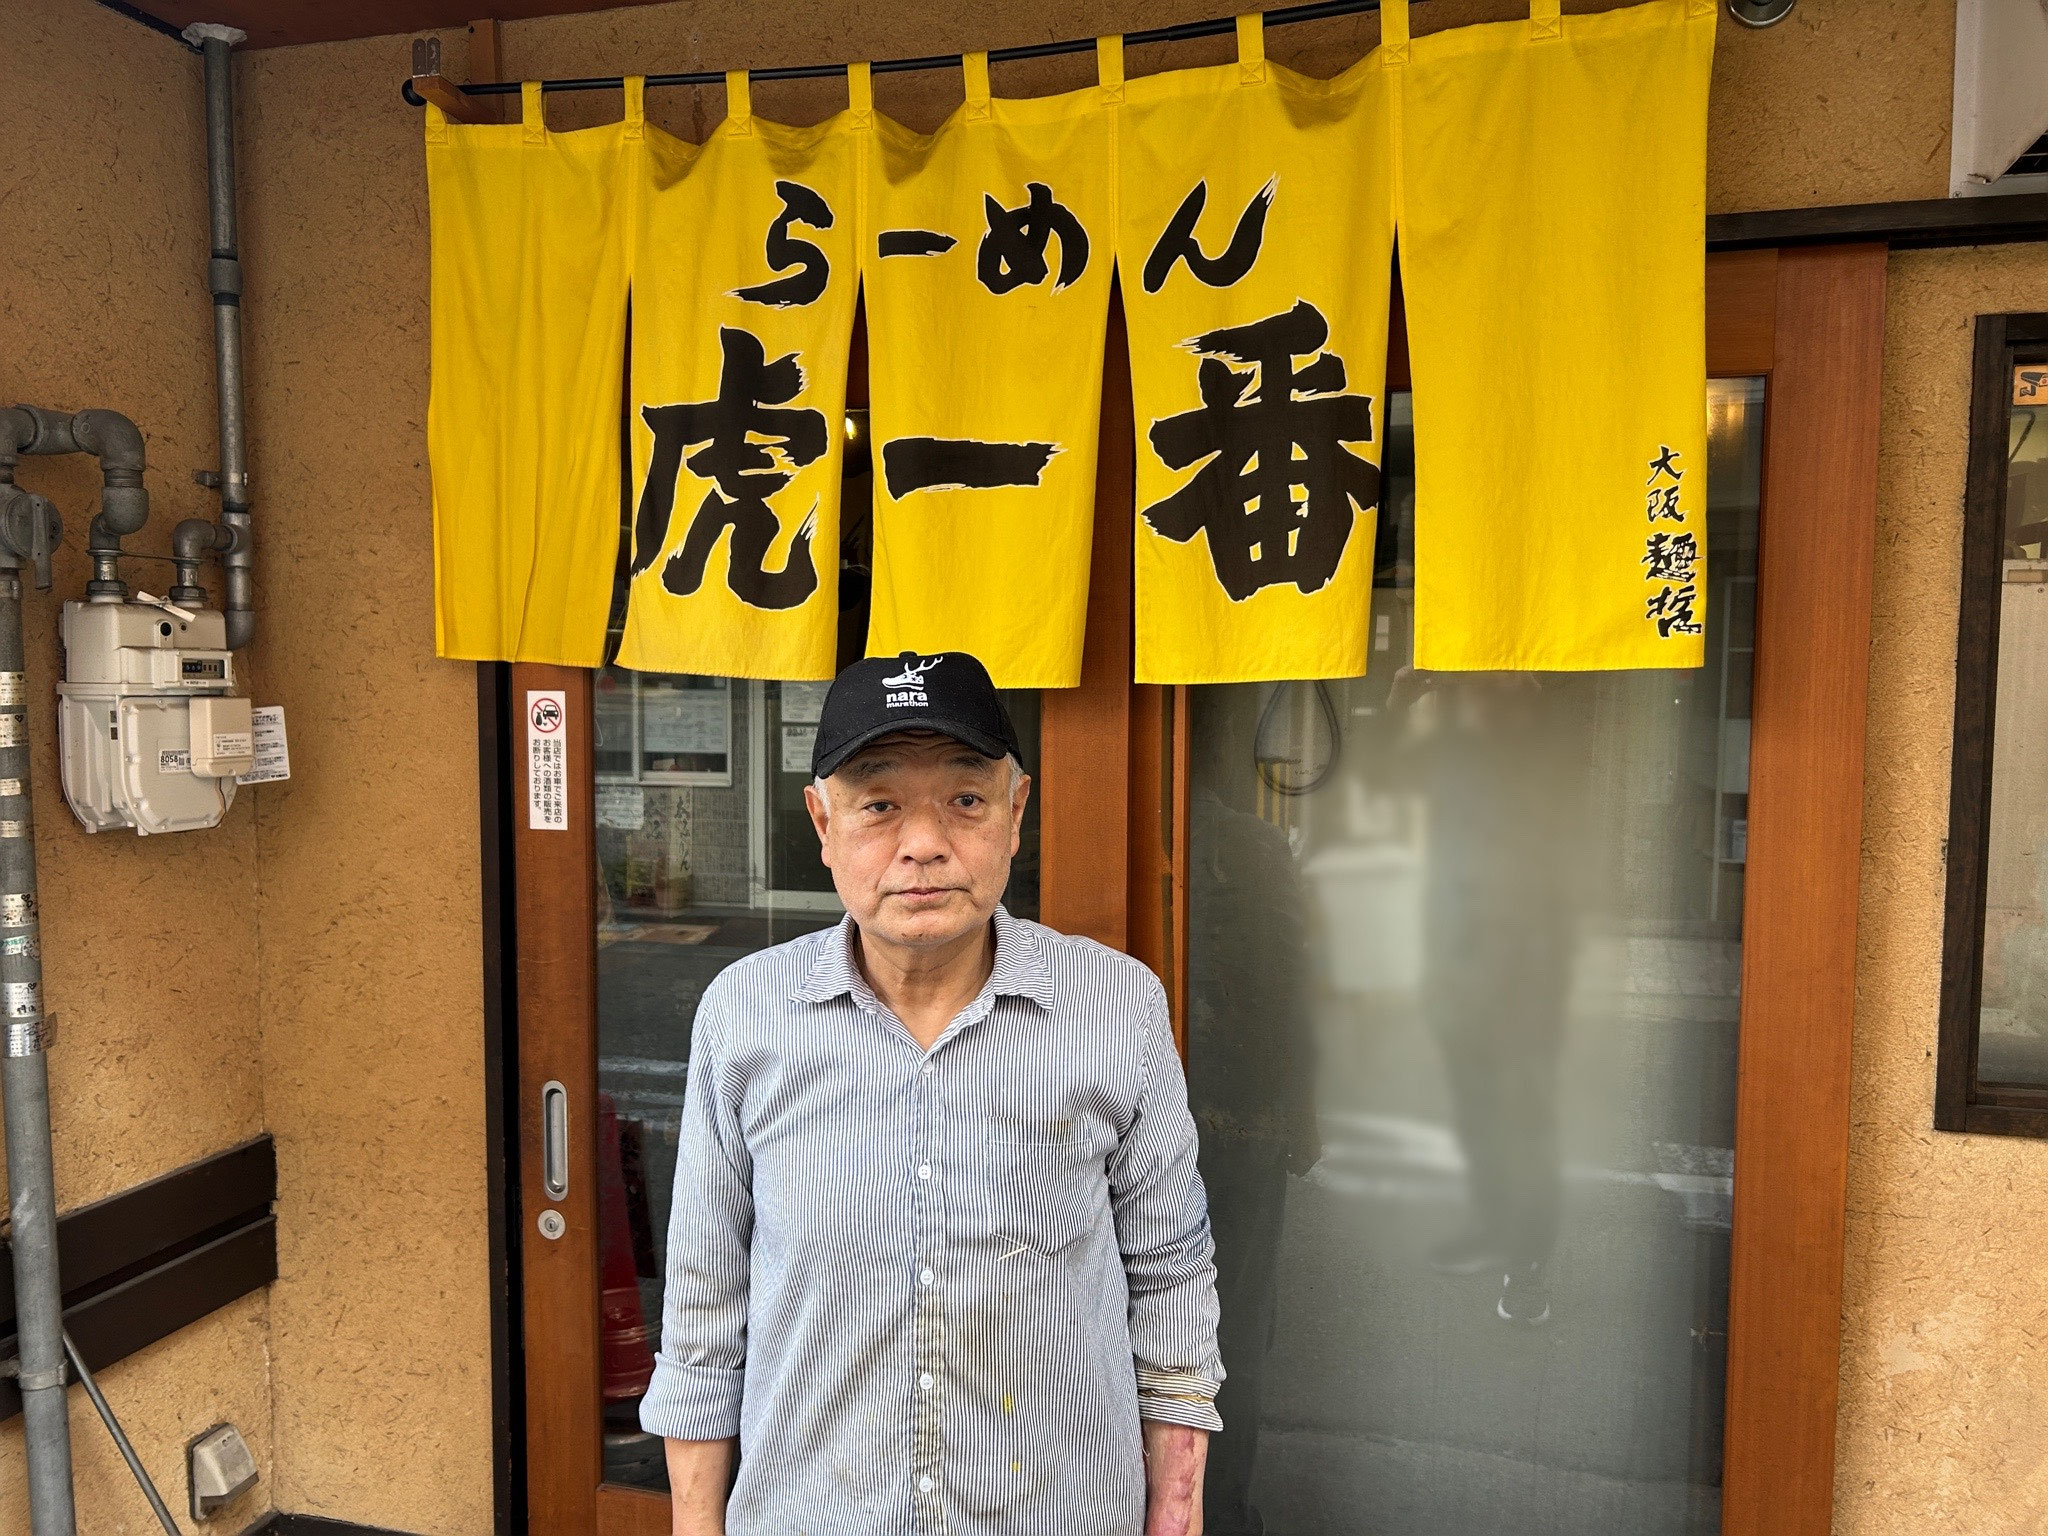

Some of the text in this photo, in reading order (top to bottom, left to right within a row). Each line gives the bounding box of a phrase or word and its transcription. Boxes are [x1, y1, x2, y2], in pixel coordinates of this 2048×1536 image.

[722, 173, 1280, 309] らーめん
[630, 296, 1382, 611] 虎一番
[886, 691, 927, 702] nara
[160, 755, 178, 763] 8058
